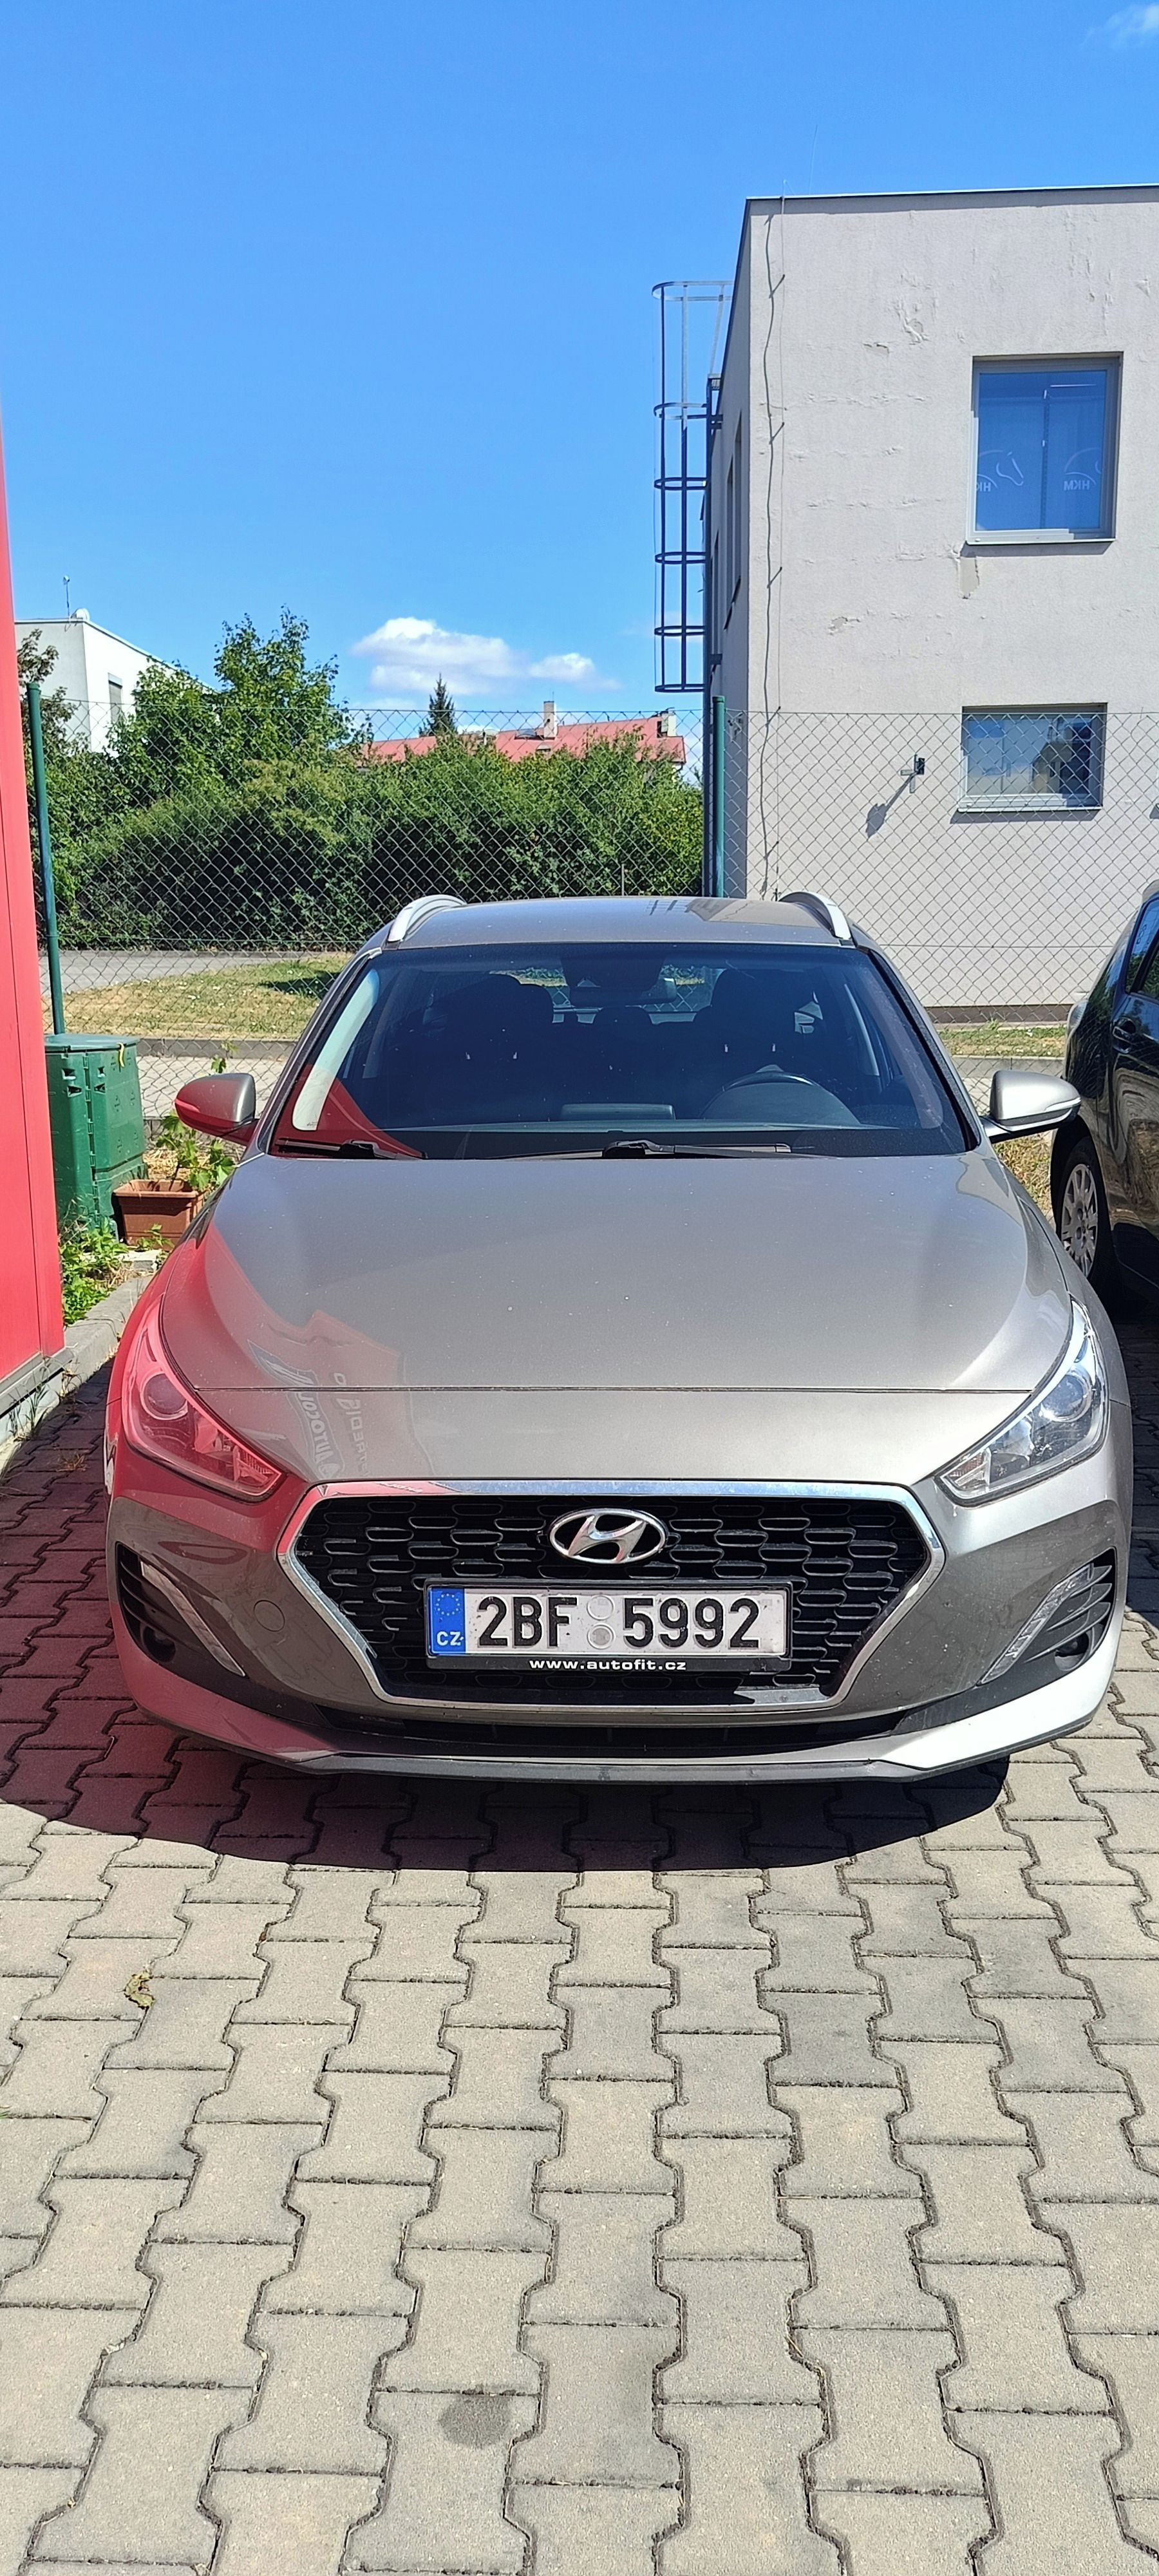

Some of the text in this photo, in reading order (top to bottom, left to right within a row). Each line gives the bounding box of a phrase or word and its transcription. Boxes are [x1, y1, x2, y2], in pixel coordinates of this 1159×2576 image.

[477, 1596, 759, 1647] 2BF 5992
[437, 1631, 463, 1646] CZ
[529, 1659, 686, 1671] www.autofit.cz
